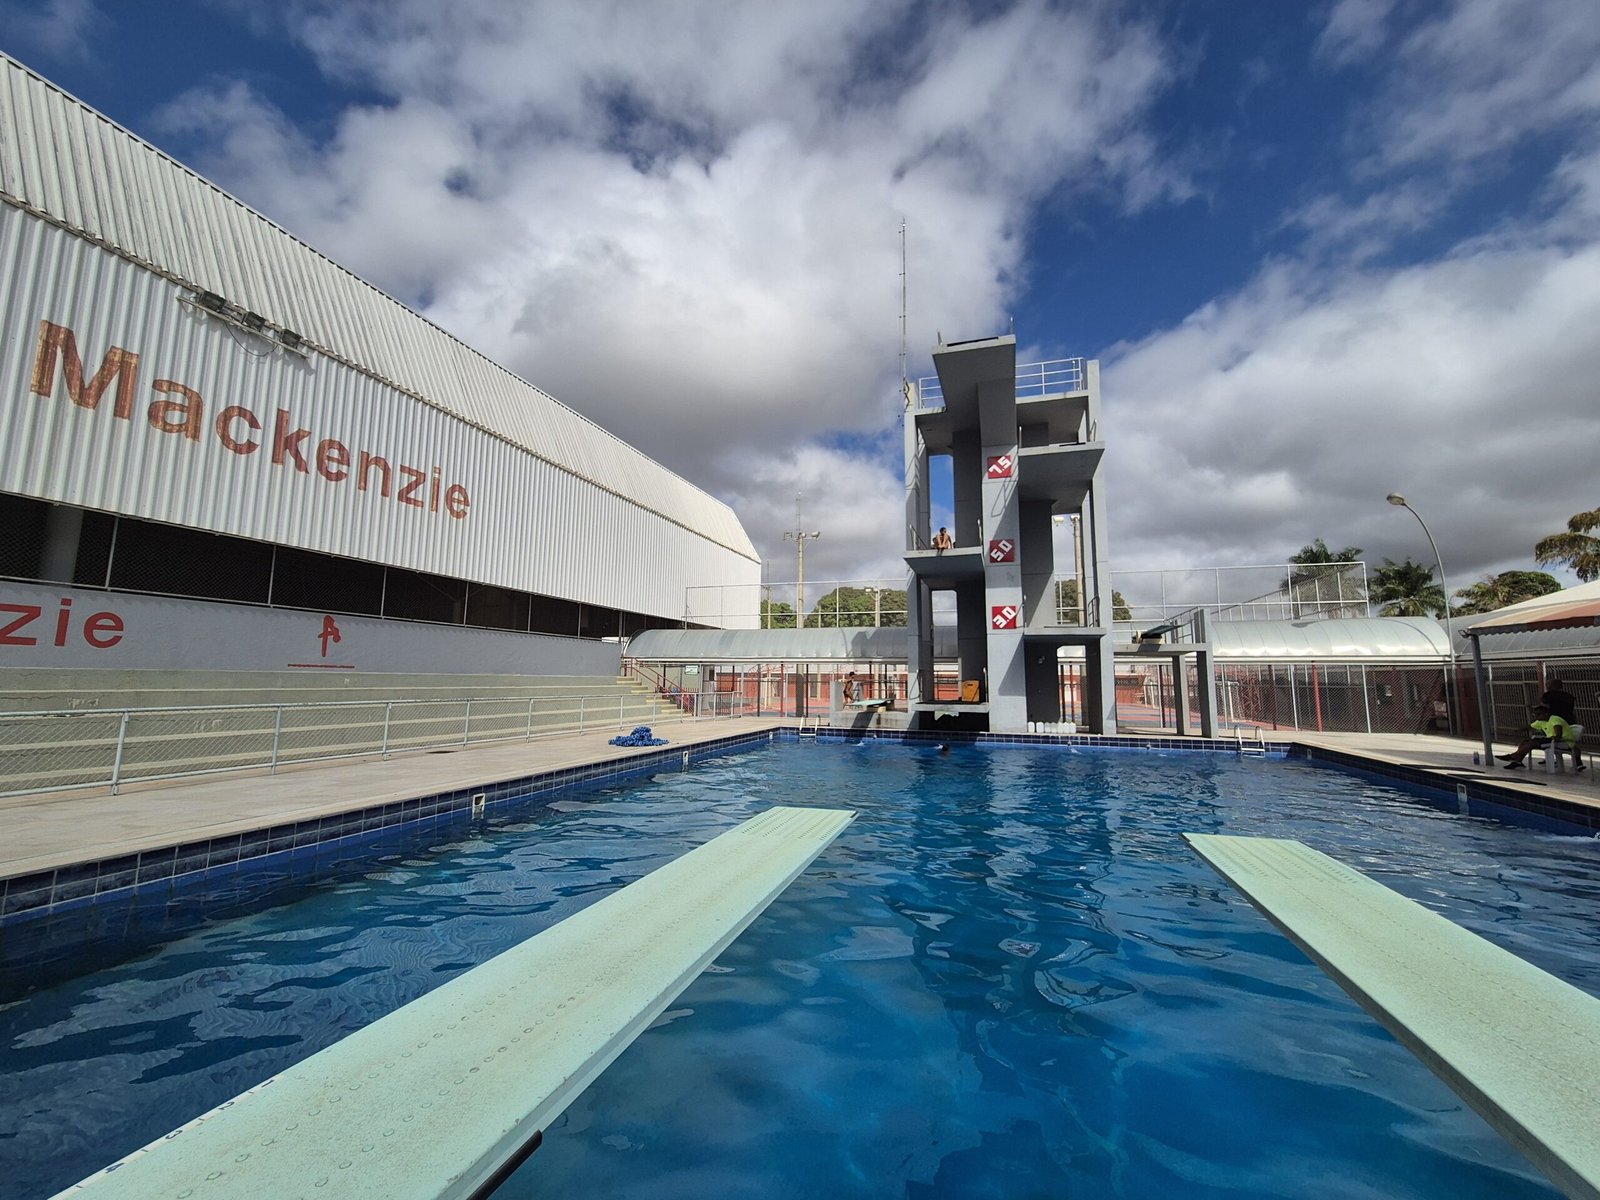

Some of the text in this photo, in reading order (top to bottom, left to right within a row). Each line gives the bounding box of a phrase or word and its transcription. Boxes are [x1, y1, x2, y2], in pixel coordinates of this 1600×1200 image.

[30, 320, 471, 519] Mackenzie
[988, 456, 1012, 474] 7.5
[990, 540, 1013, 562] 5.0
[0, 598, 124, 649] zie
[992, 606, 1016, 629] 3.0
